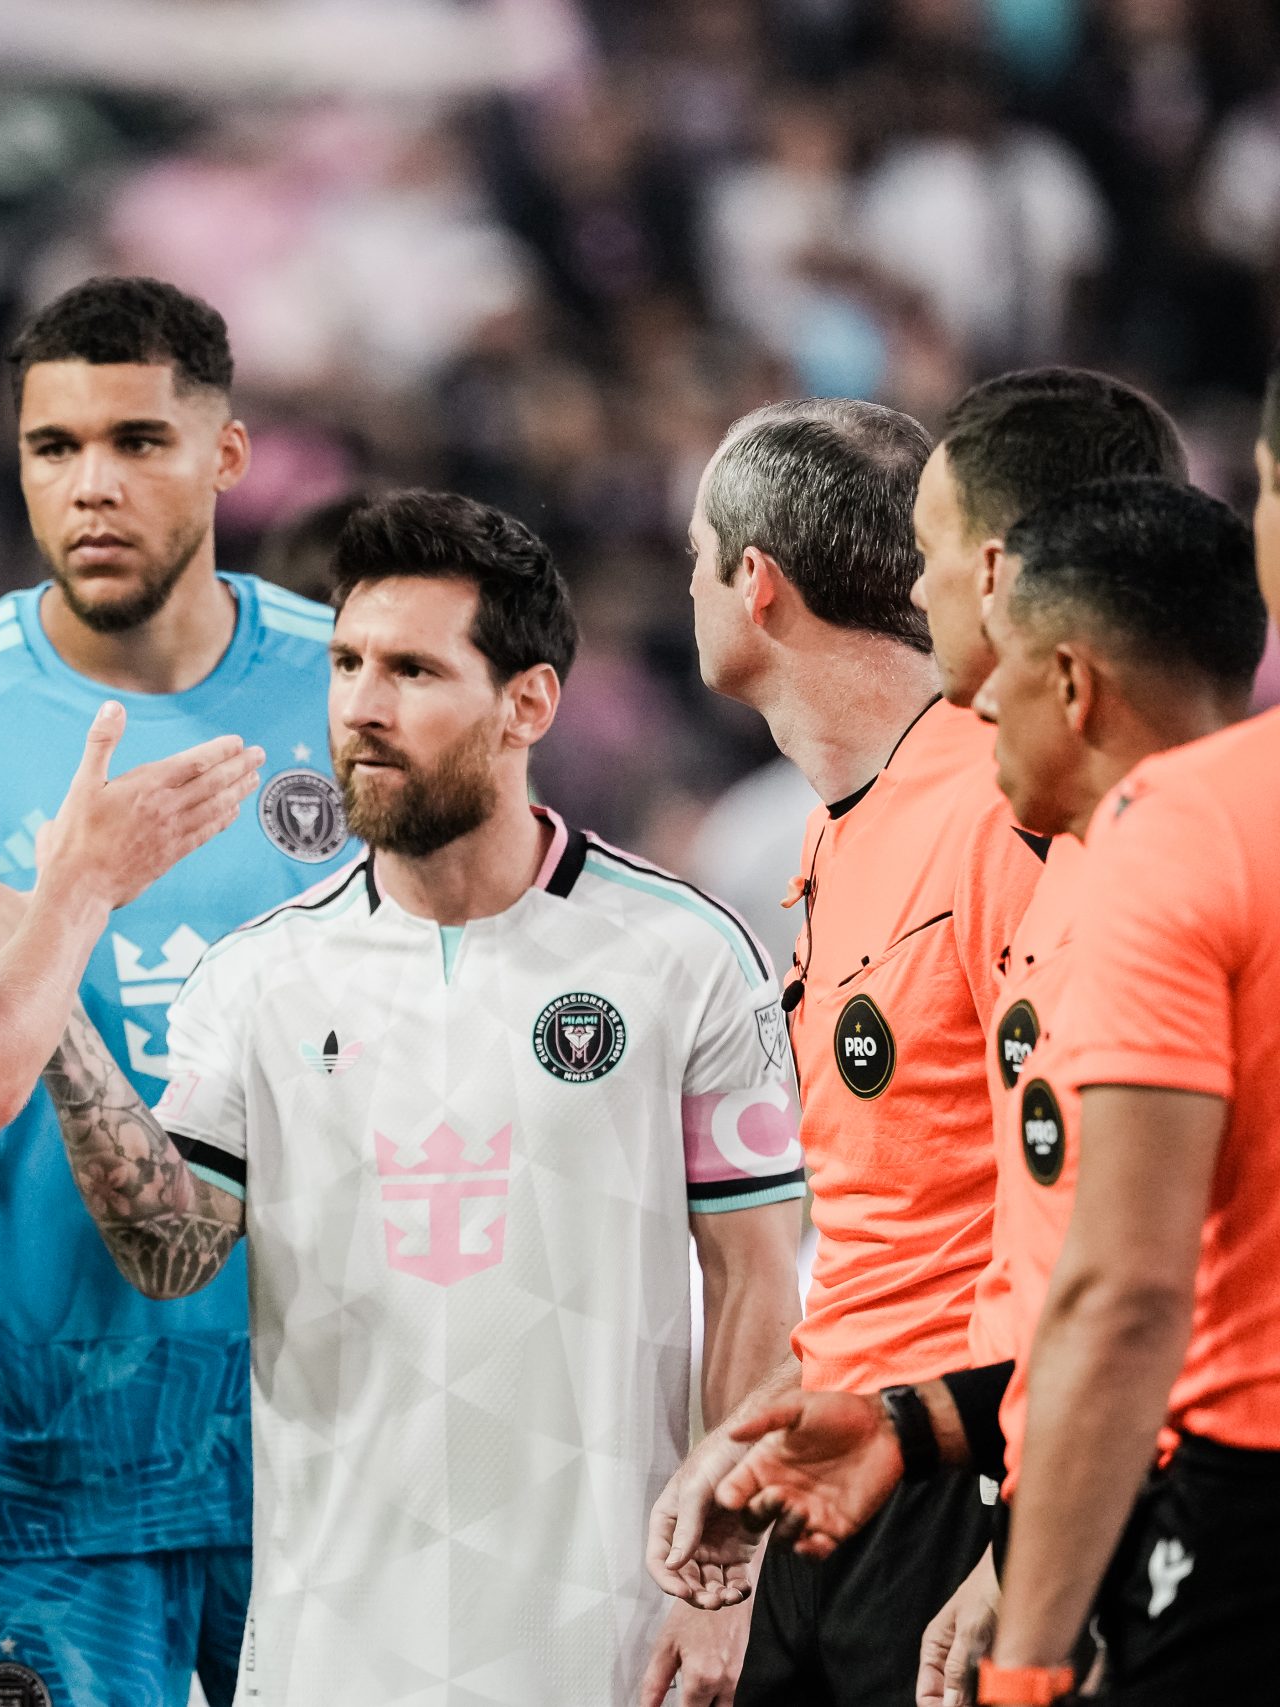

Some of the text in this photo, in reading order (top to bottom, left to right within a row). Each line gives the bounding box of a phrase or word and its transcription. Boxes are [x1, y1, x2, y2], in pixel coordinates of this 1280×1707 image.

[536, 995, 608, 1034] INTERNACIONAL
[561, 1016, 598, 1025] MIAMI
[609, 1010, 619, 1023] DE
[759, 1007, 778, 1027] MLS
[535, 1038, 548, 1063] CLUB
[844, 1036, 877, 1057] PRO
[563, 1071, 595, 1082] MMXX
[711, 1083, 803, 1178] C
